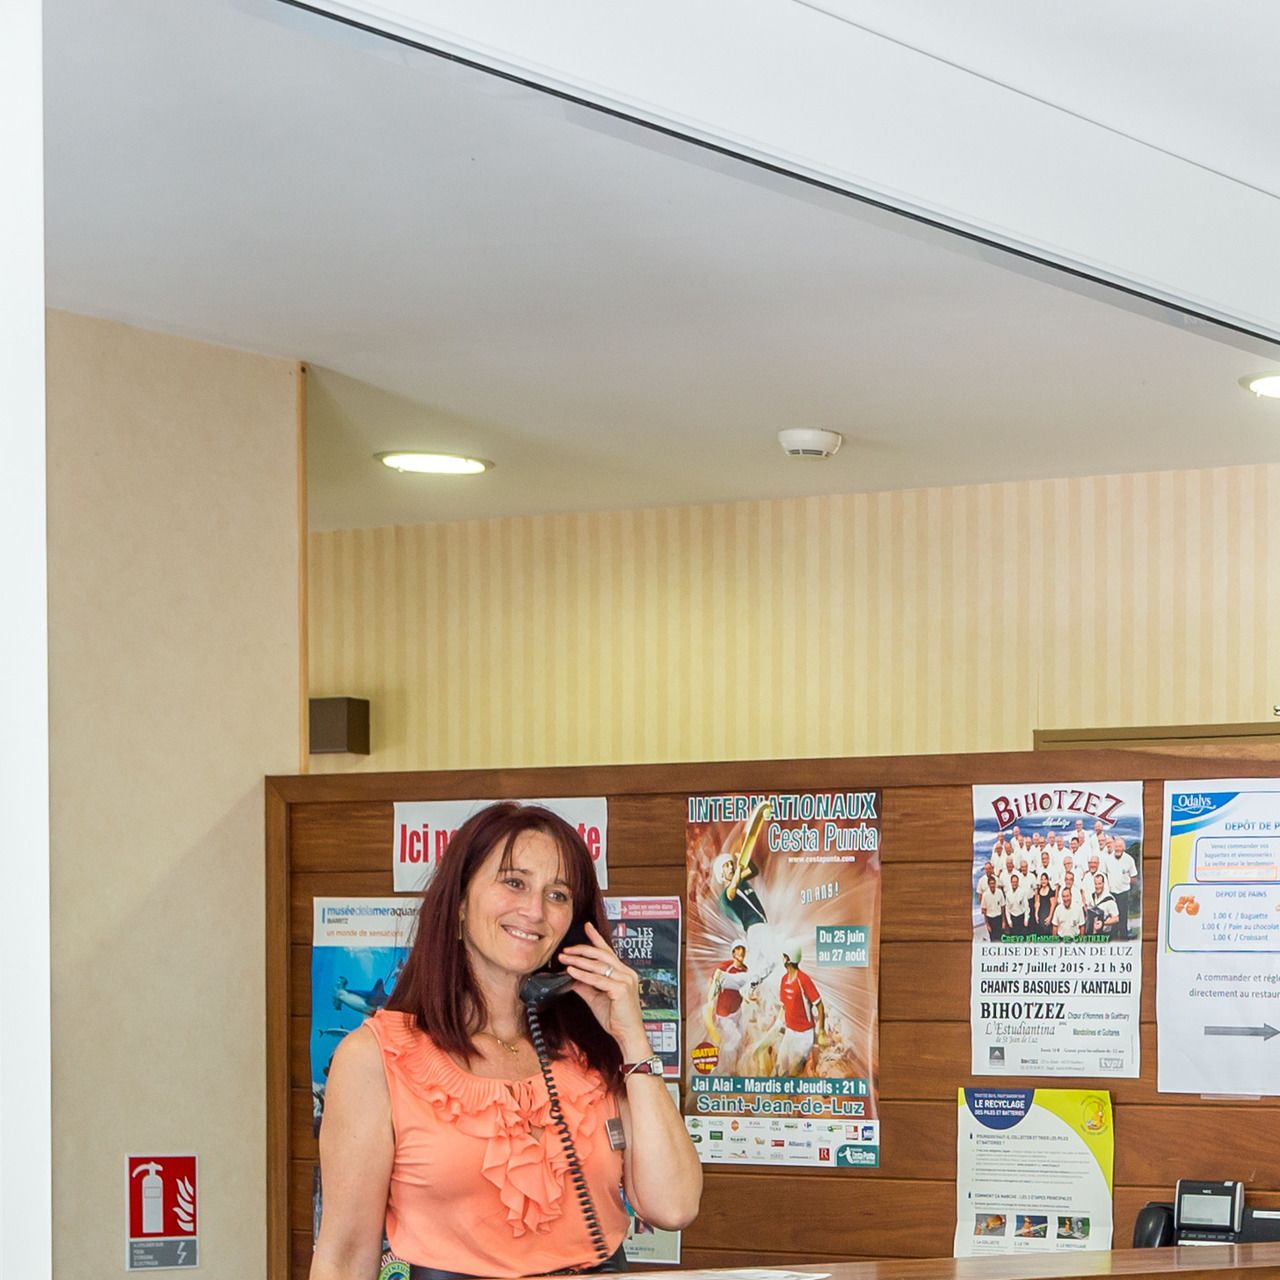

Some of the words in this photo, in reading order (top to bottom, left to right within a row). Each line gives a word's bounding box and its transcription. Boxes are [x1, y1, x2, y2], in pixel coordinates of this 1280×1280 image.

[1178, 794, 1212, 807] Odalys
[1259, 822, 1271, 831] DE
[400, 823, 429, 864] Ici
[768, 822, 819, 852] Cesta
[824, 822, 877, 852] Punta
[637, 927, 653, 937] LES
[819, 930, 831, 943] Du
[834, 930, 845, 943] 25
[847, 929, 865, 945] juin
[628, 948, 653, 959] SARE
[819, 951, 830, 962] au
[832, 950, 843, 962] 27
[845, 949, 866, 962] août
[982, 947, 1021, 957] EGLISE
[1024, 947, 1041, 956] DE
[1043, 947, 1056, 956] ST
[1058, 947, 1086, 958] JEAN
[1090, 947, 1106, 957] DE
[1110, 947, 1133, 957] LUZ
[981, 962, 1009, 973] Lundi
[1011, 963, 1023, 973] 27
[1025, 962, 1056, 975] Juillet
[1060, 963, 1084, 973] 2015
[1094, 963, 1106, 973] 21
[1110, 962, 1116, 973] h
[1119, 962, 1133, 973] 30
[1196, 973, 1202, 981] A
[1204, 973, 1251, 982] commander
[1253, 974, 1262, 982] et
[980, 980, 1020, 994] CHANTS
[1023, 980, 1070, 995] BASQUES
[1073, 980, 1078, 994] /
[1081, 981, 1132, 994] KANTALDI
[1189, 988, 1238, 997] directement
[1239, 990, 1250, 998] au
[980, 1002, 1066, 1020] BIHOTZEZ
[985, 1021, 1056, 1035] L'Estudiantina
[692, 1078, 710, 1092] Jai
[713, 1078, 733, 1092] Alai
[745, 1079, 782, 1094] Mardis
[784, 1080, 794, 1094] et
[796, 1080, 833, 1094] Jeudis
[842, 1080, 855, 1094] 21
[859, 1081, 867, 1095] h
[697, 1095, 865, 1116] Saint-Jean-de-Luz
[974, 1099, 983, 1108] LE
[985, 1099, 1025, 1109] RECYCLAGE
